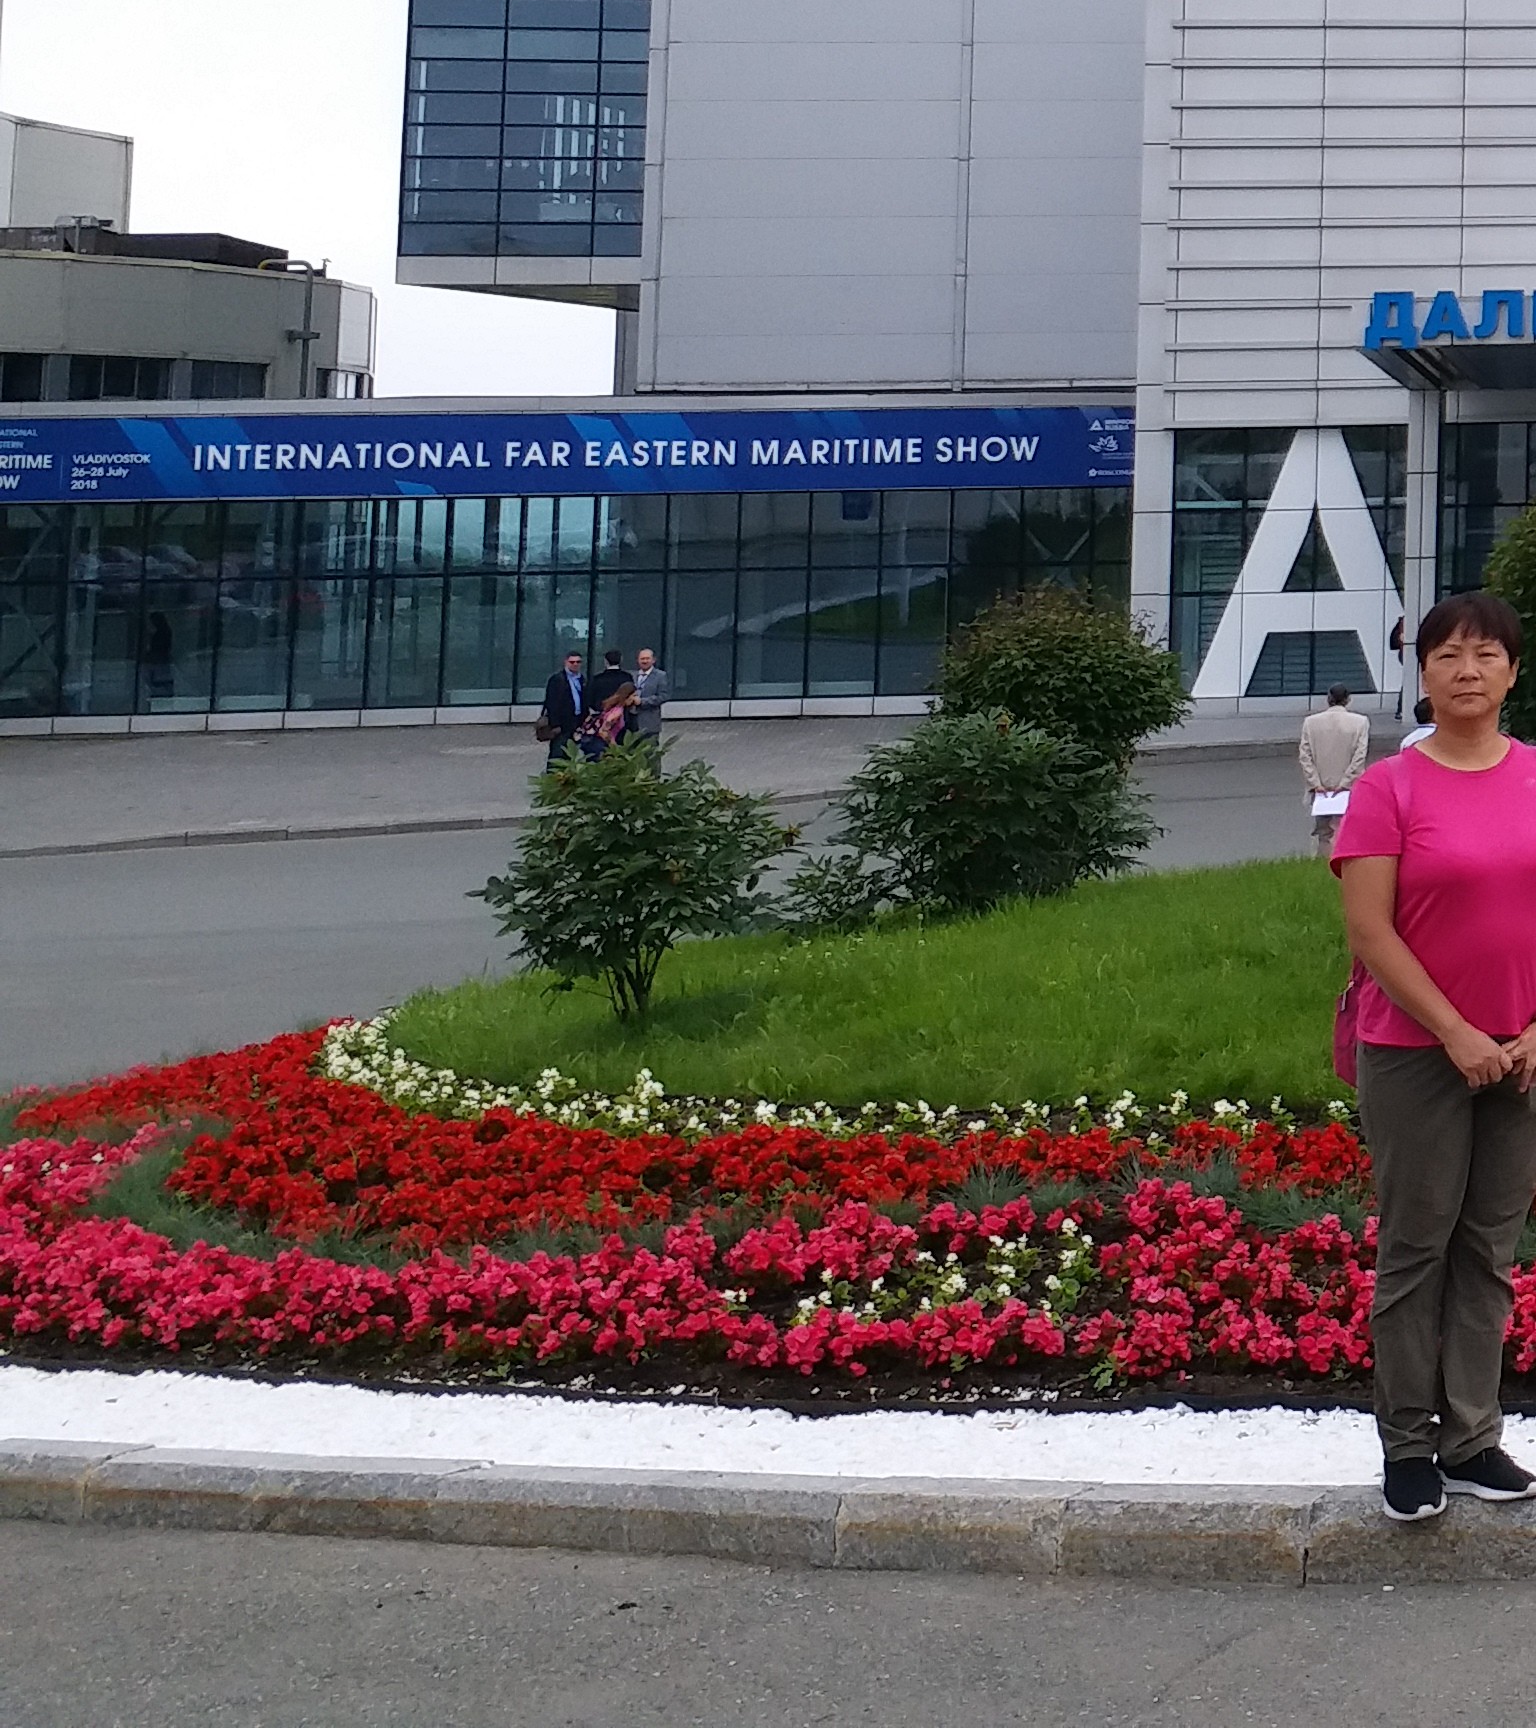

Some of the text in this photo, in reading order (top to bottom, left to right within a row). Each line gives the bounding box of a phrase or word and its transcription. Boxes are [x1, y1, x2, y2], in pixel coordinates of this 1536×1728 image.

[72, 453, 151, 465] VLADIVOSTOK
[193, 435, 1040, 471] INTERNATIONAL FAR EASTERN MARITIME SHOW
[105, 466, 130, 478] July
[70, 479, 99, 491] 2018
[1190, 428, 1405, 698] A
